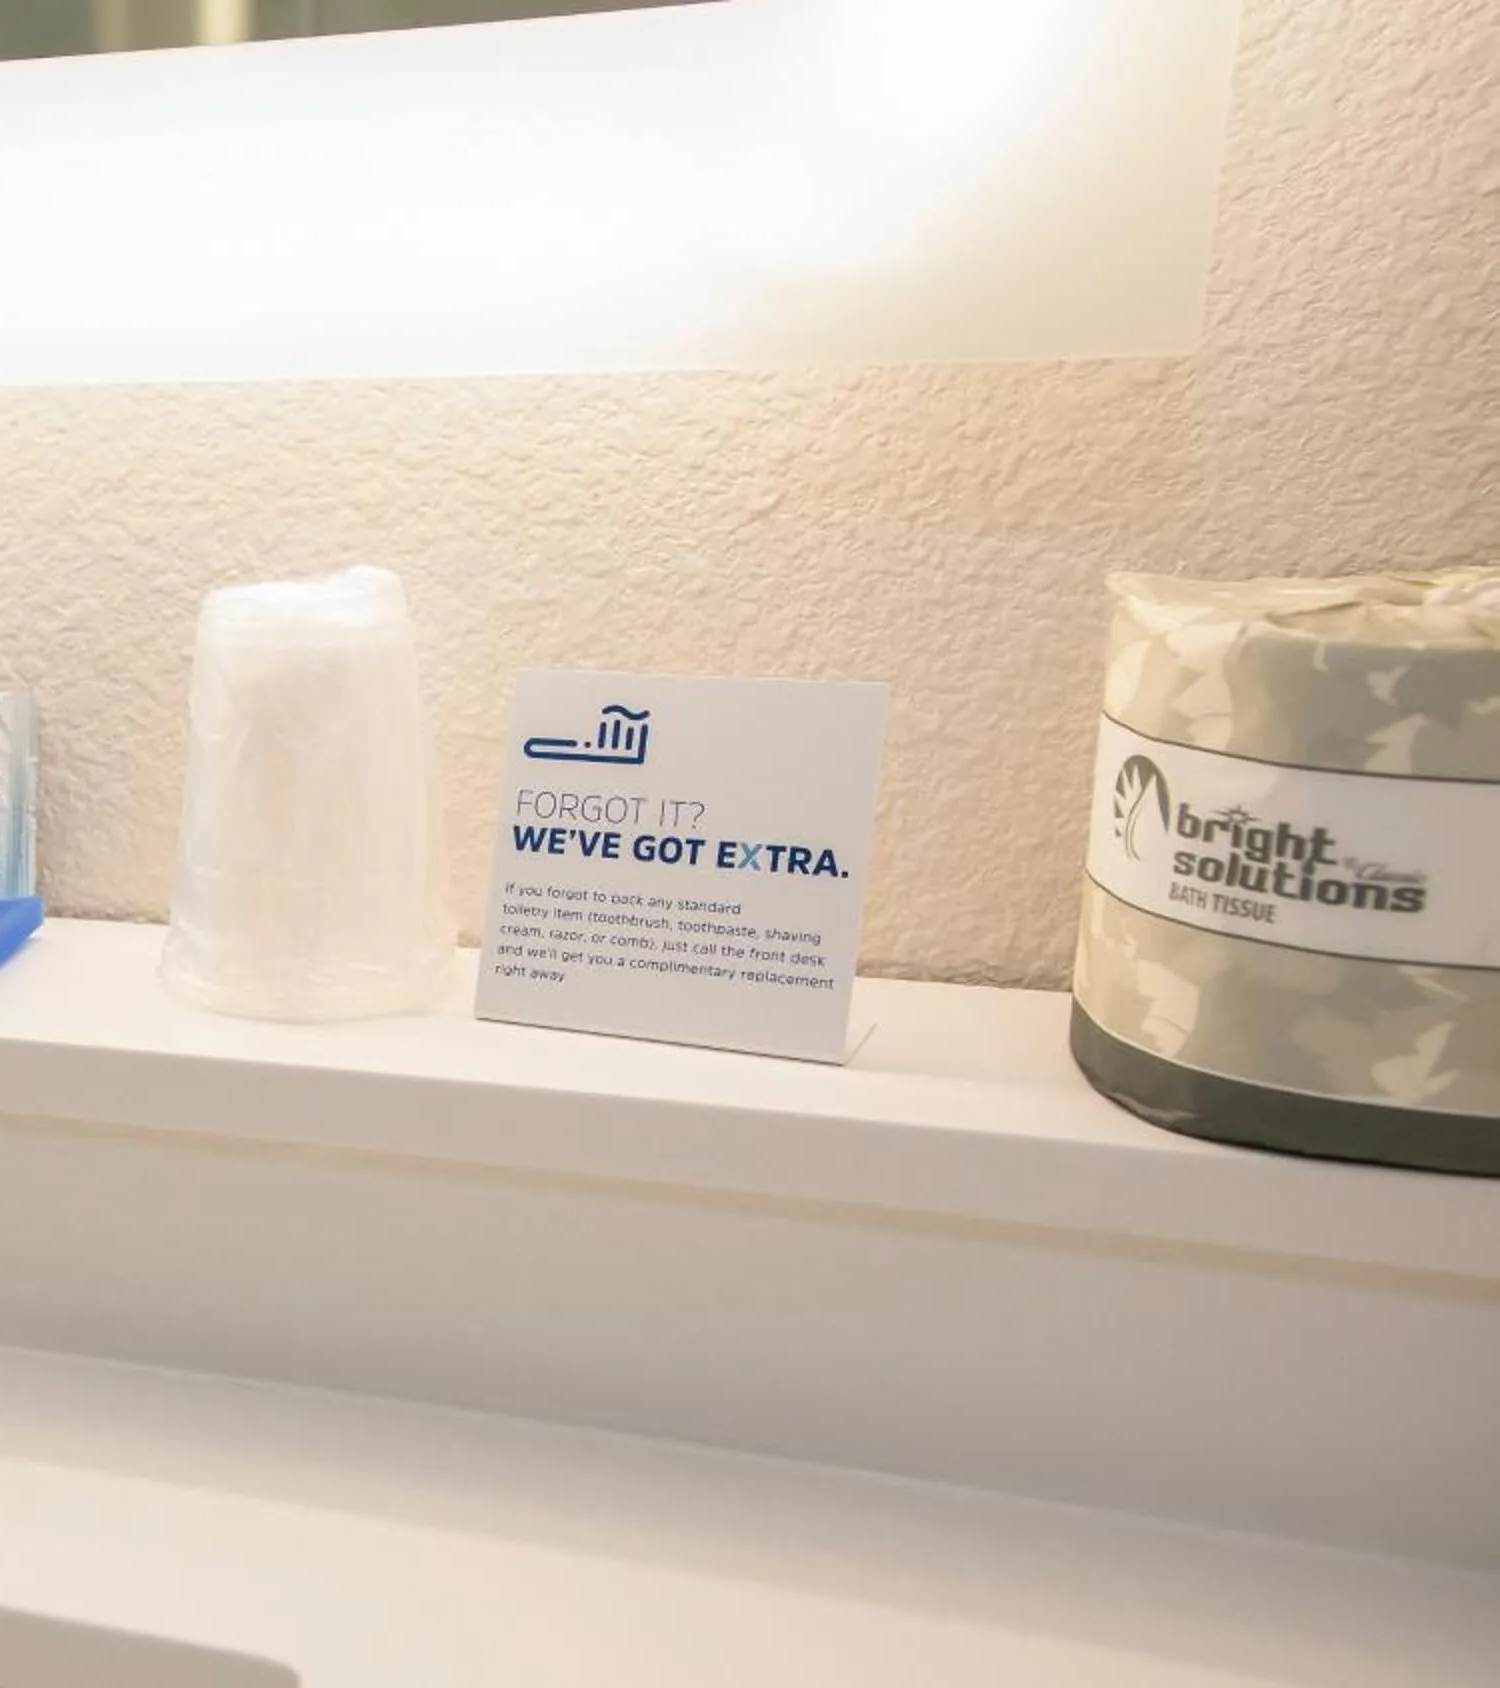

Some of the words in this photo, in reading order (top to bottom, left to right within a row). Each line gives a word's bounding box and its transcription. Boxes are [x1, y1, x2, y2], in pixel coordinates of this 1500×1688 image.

[516, 789, 648, 826] FORGOT
[659, 799, 706, 829] IT?
[513, 825, 621, 860] WE'VE
[632, 834, 706, 866] GOT
[715, 840, 850, 879] EXTRA.
[1176, 801, 1338, 866] bright
[519, 886, 543, 898] you
[547, 885, 589, 902] forgot
[593, 891, 607, 904] to
[611, 894, 643, 907] pack
[647, 898, 673, 911] any
[677, 899, 742, 916] standard
[1168, 881, 1208, 908] BATH
[1211, 892, 1278, 924] TISSUE
[1173, 850, 1428, 914] solutions
[502, 903, 549, 919] toiletry
[553, 908, 583, 922] item
[587, 911, 674, 932] (toothbrush,
[677, 920, 761, 940] toothpaste,
[764, 927, 822, 947] shaving
[496, 944, 524, 957] and
[561, 950, 584, 964] get
[588, 953, 613, 966] you
[616, 956, 626, 967] a
[629, 957, 737, 980] complimentary
[740, 969, 836, 990] replacement
[590, 932, 604, 944] or
[691, 942, 717, 956] call
[721, 944, 745, 959] the
[749, 946, 786, 963] front
[789, 951, 826, 967] desk
[494, 963, 526, 978] right
[529, 968, 566, 983] away
